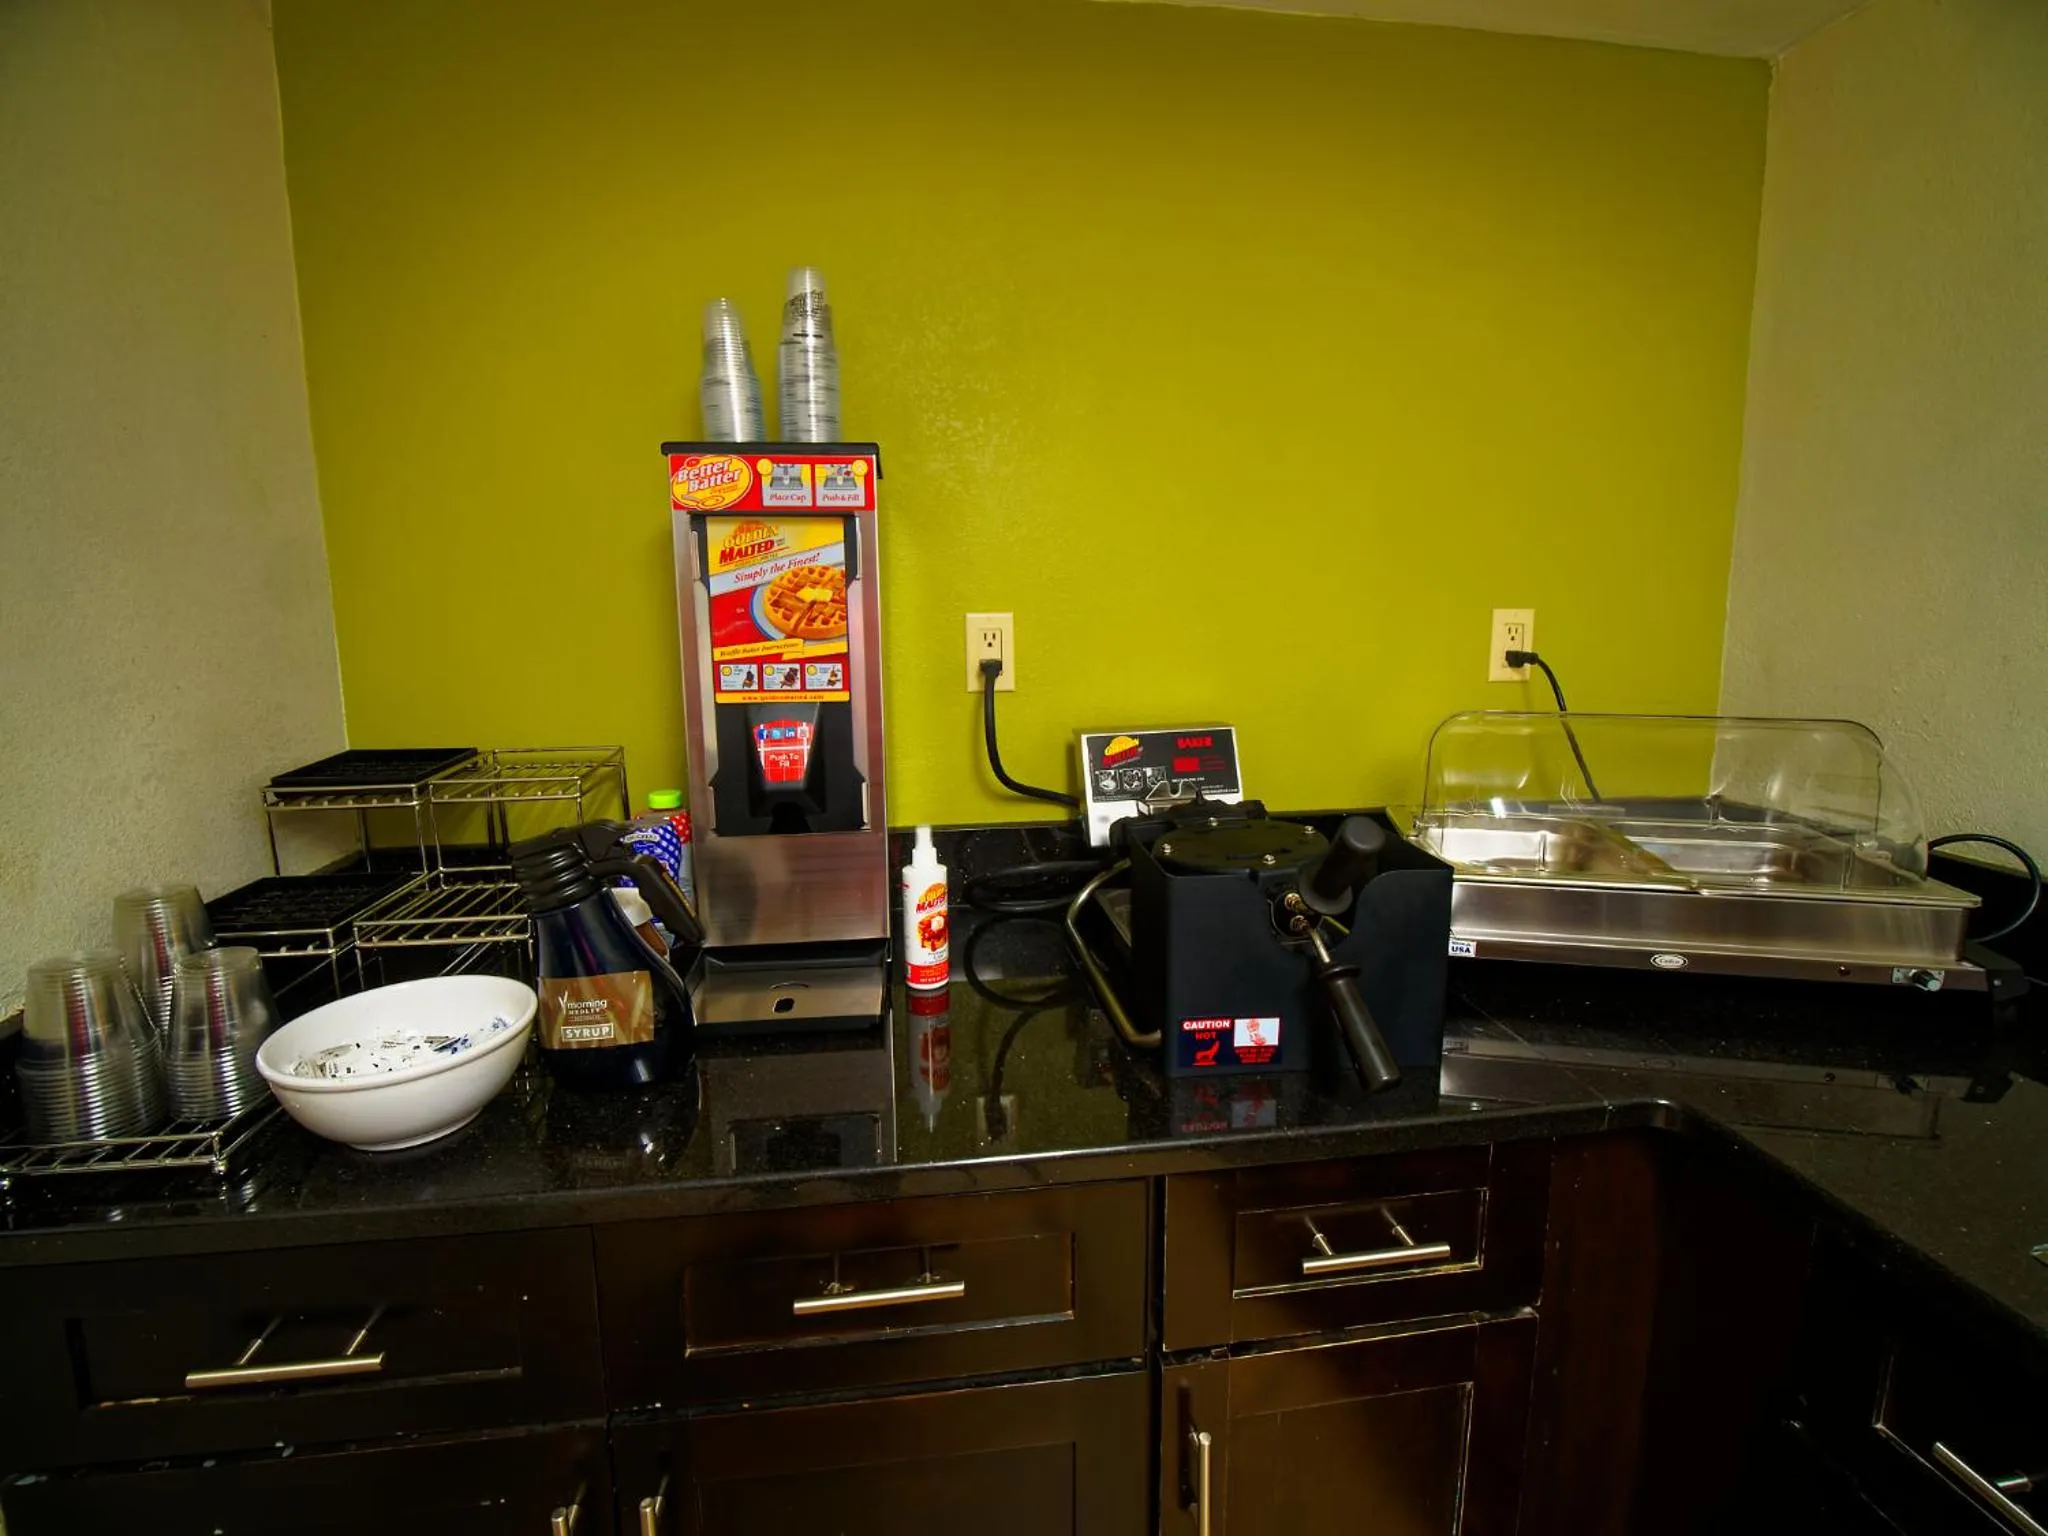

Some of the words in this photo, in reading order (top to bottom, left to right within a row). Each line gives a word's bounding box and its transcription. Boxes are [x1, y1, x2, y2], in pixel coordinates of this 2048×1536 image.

[677, 459, 733, 483] Better
[688, 469, 742, 493] Batter
[719, 540, 776, 565] MALTED
[735, 562, 768, 583] Simply
[769, 561, 786, 575] the
[567, 1000, 607, 1010] morning
[566, 1026, 610, 1038] SYRUP
[1183, 1020, 1231, 1030] CAUTION
